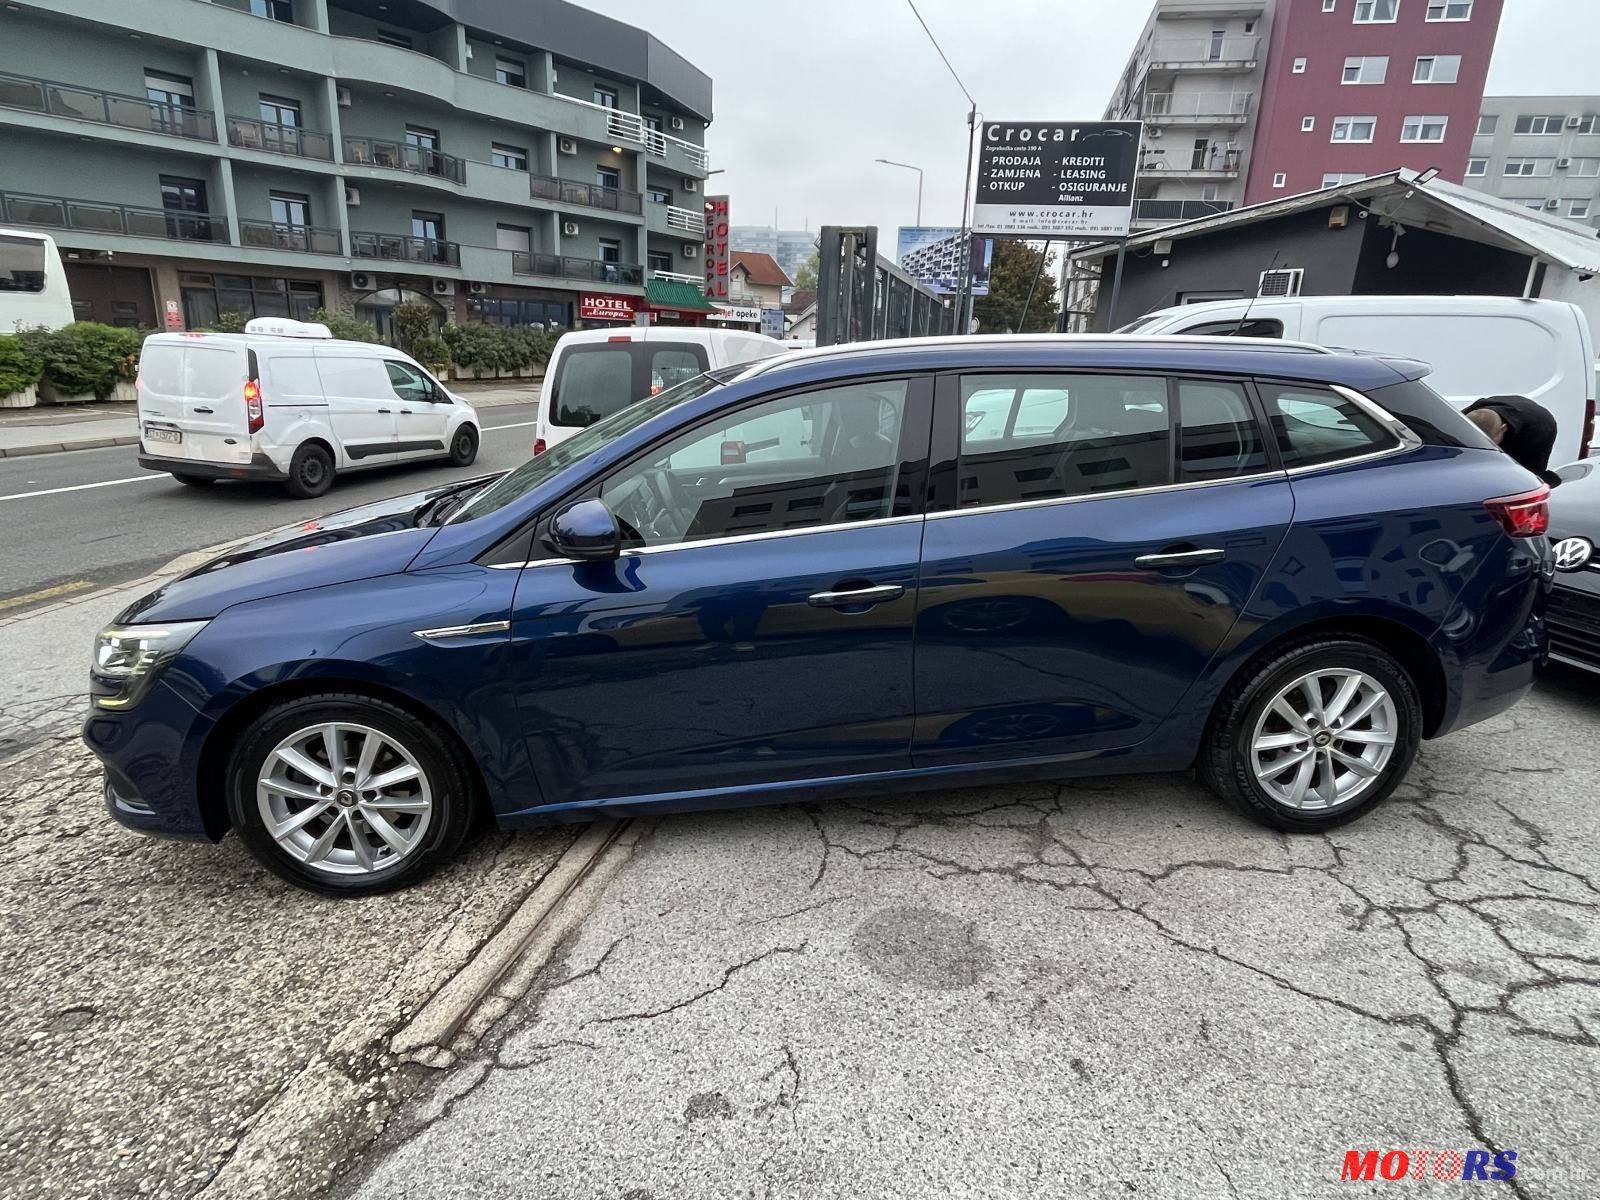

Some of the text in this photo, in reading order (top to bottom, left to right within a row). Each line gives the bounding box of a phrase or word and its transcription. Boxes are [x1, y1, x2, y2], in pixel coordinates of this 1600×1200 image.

[987, 125, 1080, 142] Crocar
[992, 156, 1041, 166] PRODAJA
[1062, 156, 1105, 166] KREDITI
[990, 168, 1041, 178] ZAMJENA
[1060, 169, 1106, 179] LEASING
[989, 181, 1026, 191] OTKUP
[1058, 182, 1128, 192] OSIGURANJE
[1058, 194, 1084, 202] Allianz
[1009, 209, 1094, 218] www.crocar.hr
[716, 201, 728, 297] HOTEL
[706, 215, 715, 297] EUROPA
[584, 297, 631, 310] HOTEL
[736, 308, 758, 320] opeke
